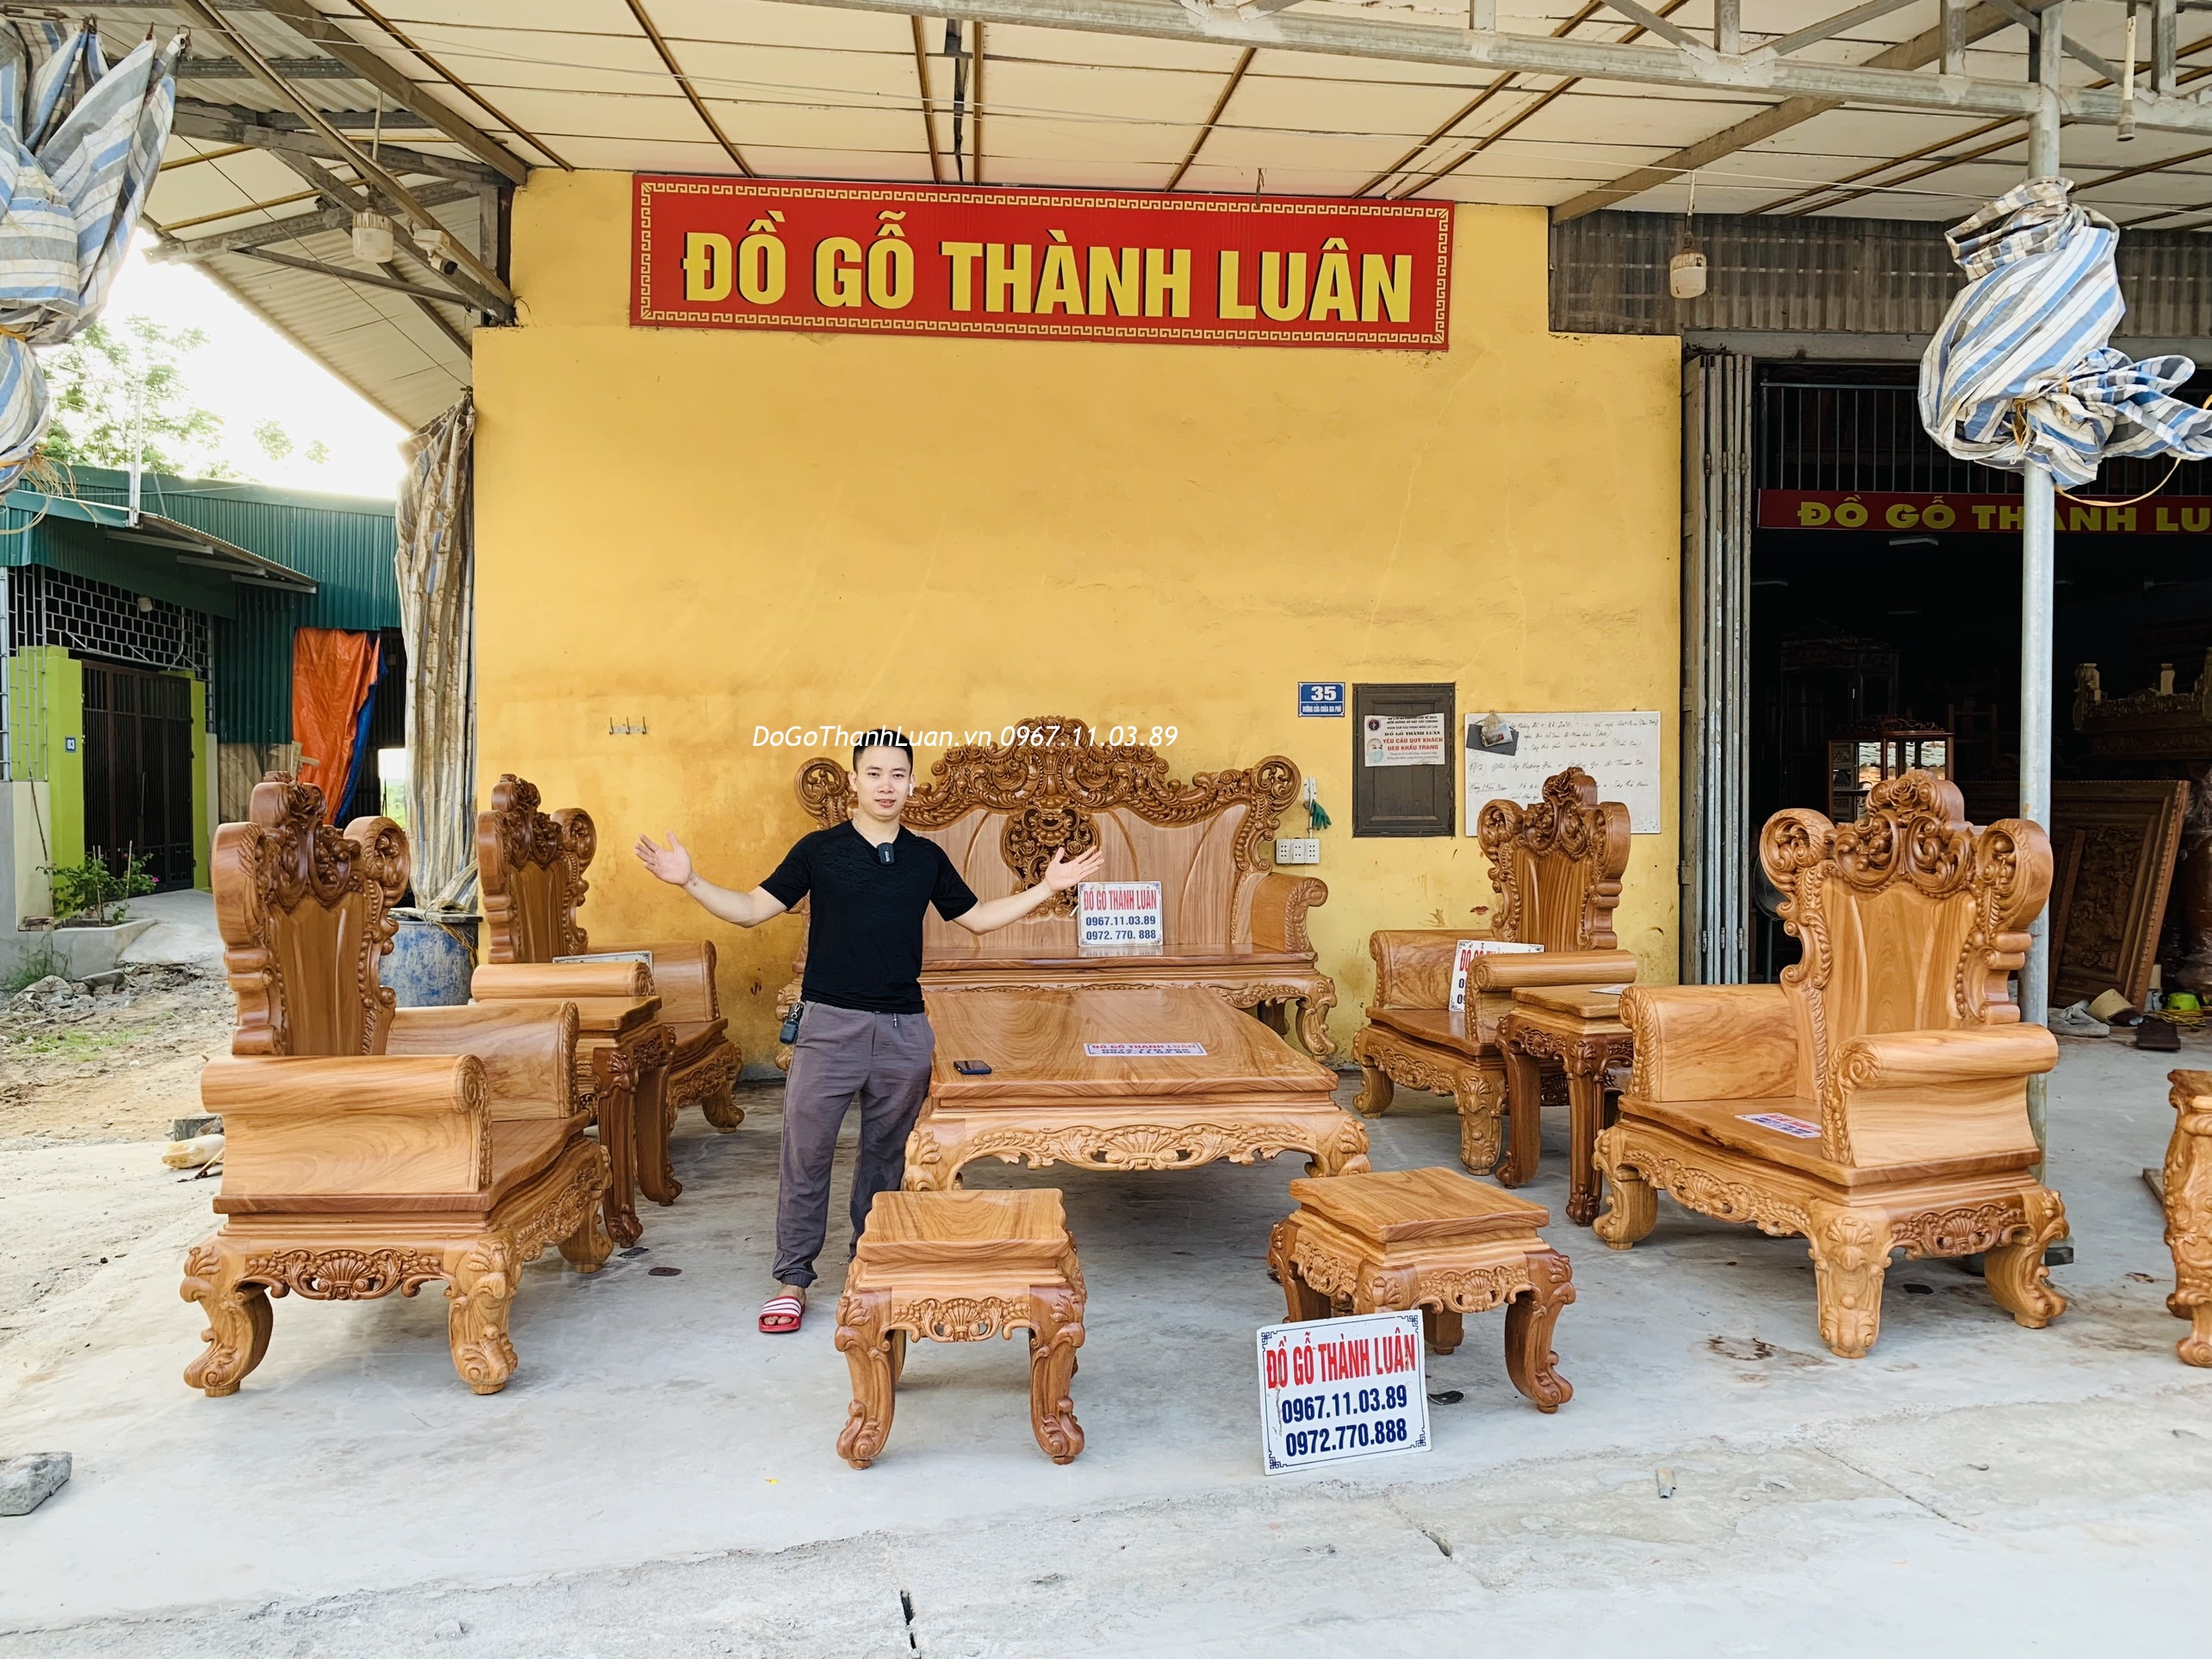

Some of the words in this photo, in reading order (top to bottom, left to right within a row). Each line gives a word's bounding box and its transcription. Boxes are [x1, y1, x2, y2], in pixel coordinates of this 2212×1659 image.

[683, 210, 787, 305] ĐỒ
[812, 209, 916, 308] GỖ
[939, 230, 1192, 318] THÀNH
[1216, 237, 1413, 323] LUÂN
[1797, 494, 1868, 528] ĐỒ
[1885, 495, 1956, 529] GỖ
[2156, 506, 2211, 532] LU
[1311, 686, 1337, 701] 35
[1109, 886, 1134, 910] THÀNH
[1137, 885, 1157, 910] LUÂN
[1085, 916, 1156, 926] 0967.11.03.89
[1266, 1335, 1289, 1389] ĐỒ
[1293, 1332, 1315, 1386] GỖ
[1318, 1333, 1370, 1382] THÀNH
[1374, 1327, 1416, 1376] LUÂN
[1282, 1384, 1407, 1424] 0967.11.03.89
[1285, 1418, 1407, 1457] 0972.770.888
